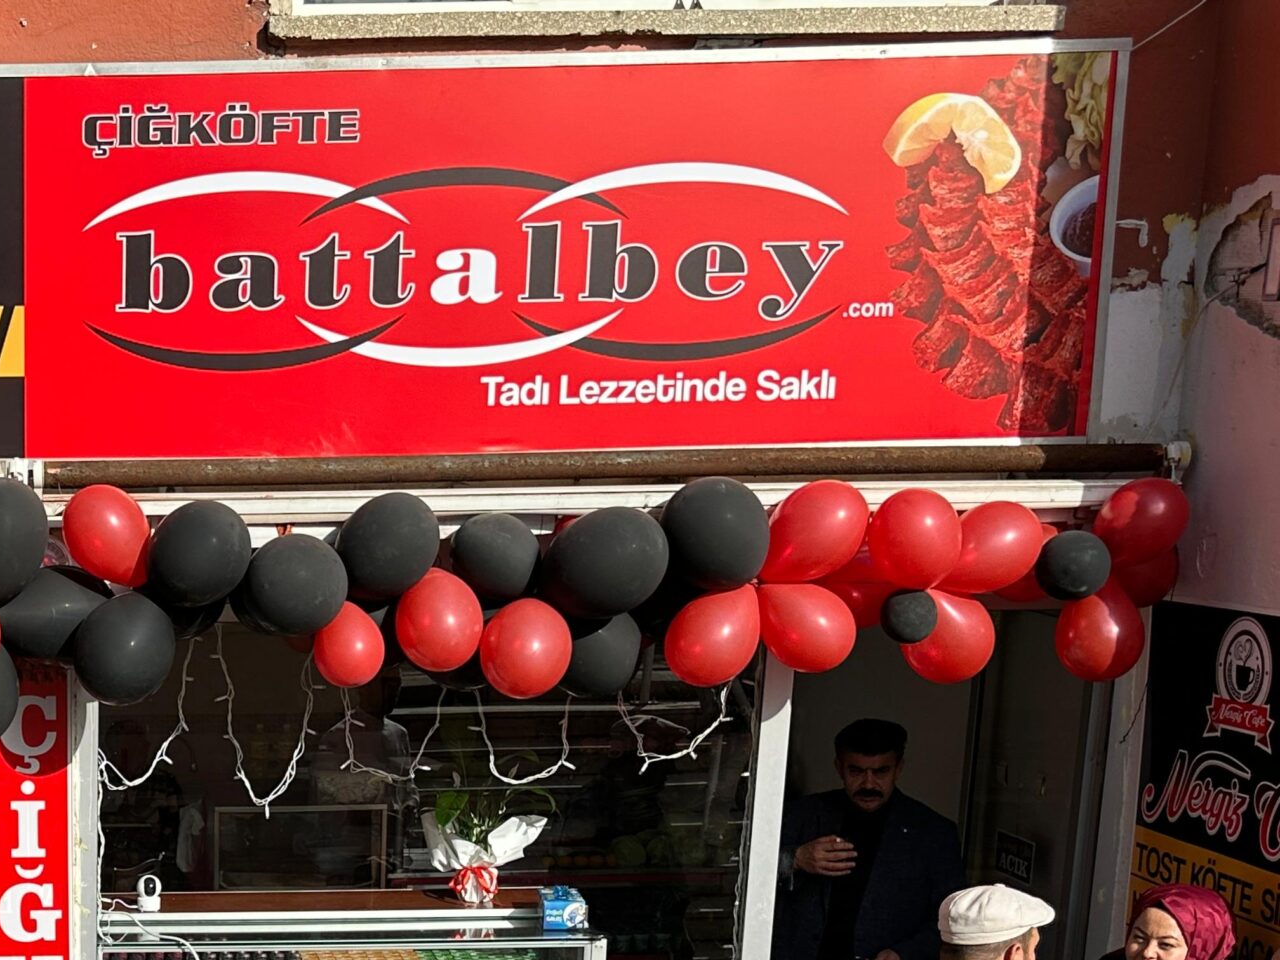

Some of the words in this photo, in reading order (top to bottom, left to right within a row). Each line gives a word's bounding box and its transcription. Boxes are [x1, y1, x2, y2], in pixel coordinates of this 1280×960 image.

[82, 102, 361, 158] ÇİĞKÖFTE
[115, 219, 844, 321] battalbey
[843, 300, 894, 319] .com
[482, 373, 548, 407] Tadı
[558, 370, 747, 405] Lezzetinde
[756, 369, 837, 402] Saklı
[1141, 749, 1251, 842] Nergiz
[1136, 843, 1186, 885] TOST
